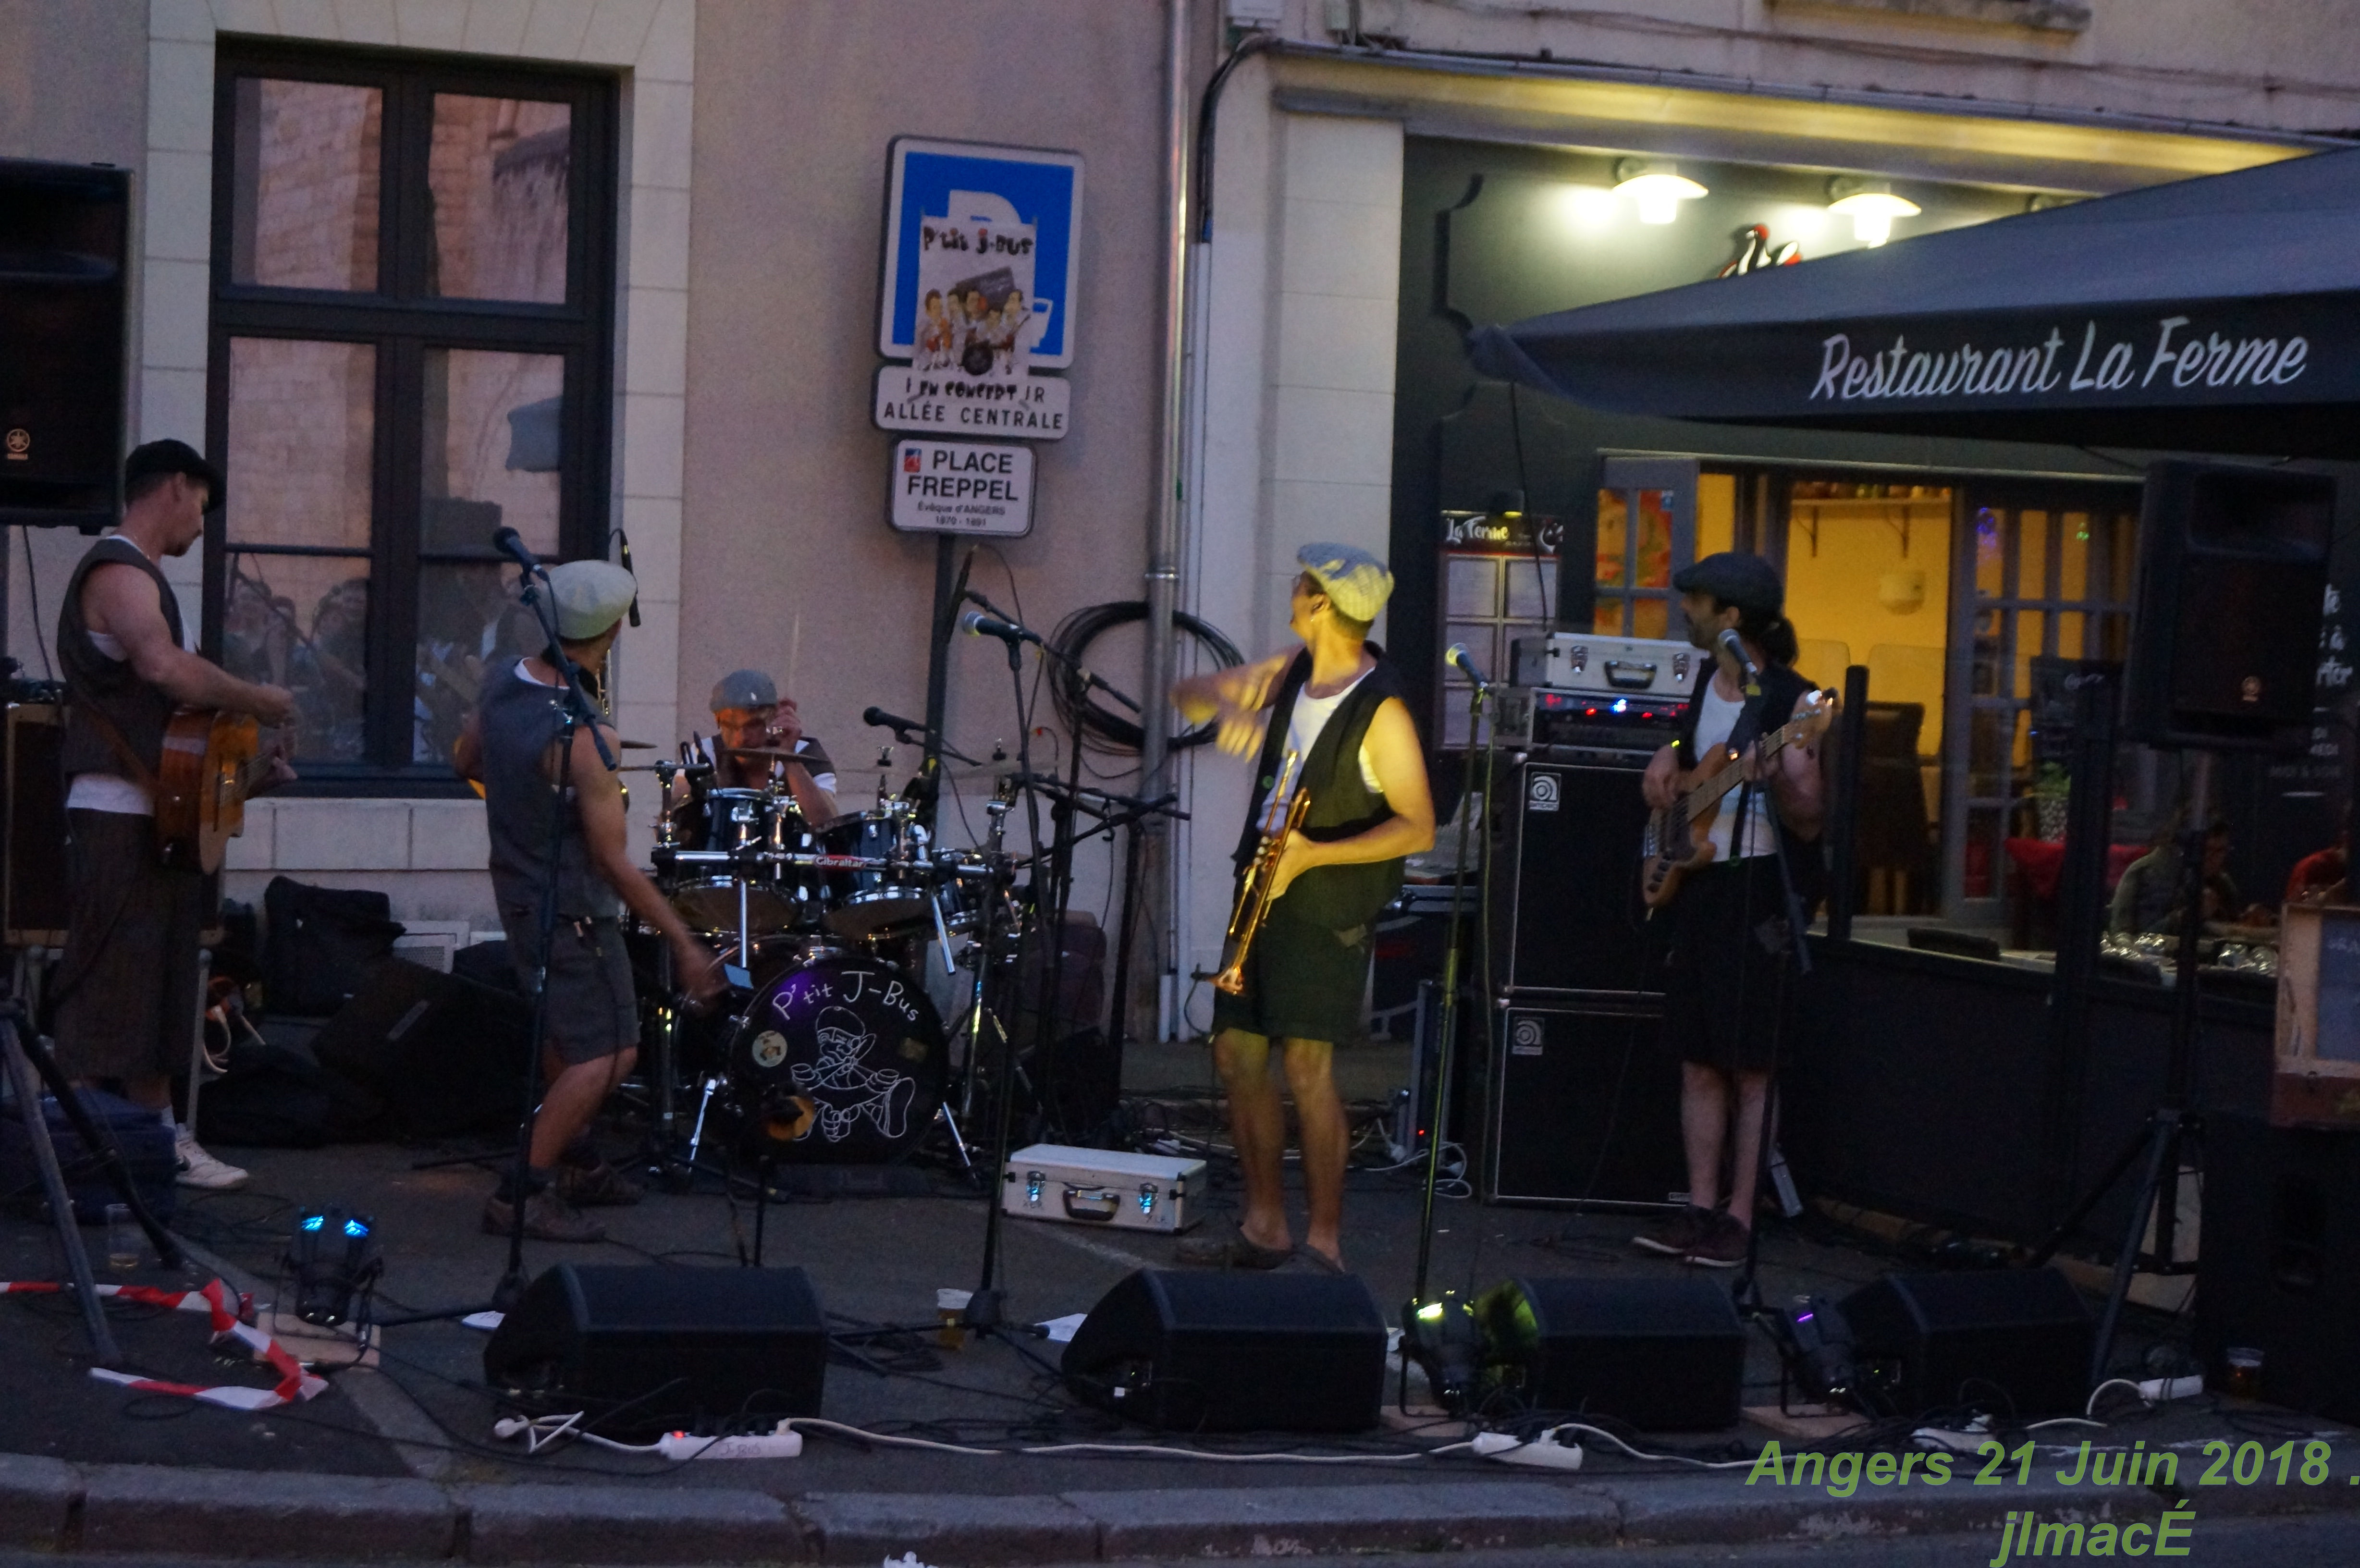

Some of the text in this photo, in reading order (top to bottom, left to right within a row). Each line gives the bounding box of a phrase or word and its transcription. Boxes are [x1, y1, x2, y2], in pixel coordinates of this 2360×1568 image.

[1810, 316, 2309, 400] Restaurant La Ferme
[884, 401, 1063, 429] ALLÉE CENTRALE
[907, 450, 1019, 501] PLACE FREPPEL
[772, 982, 834, 1020] P'tit
